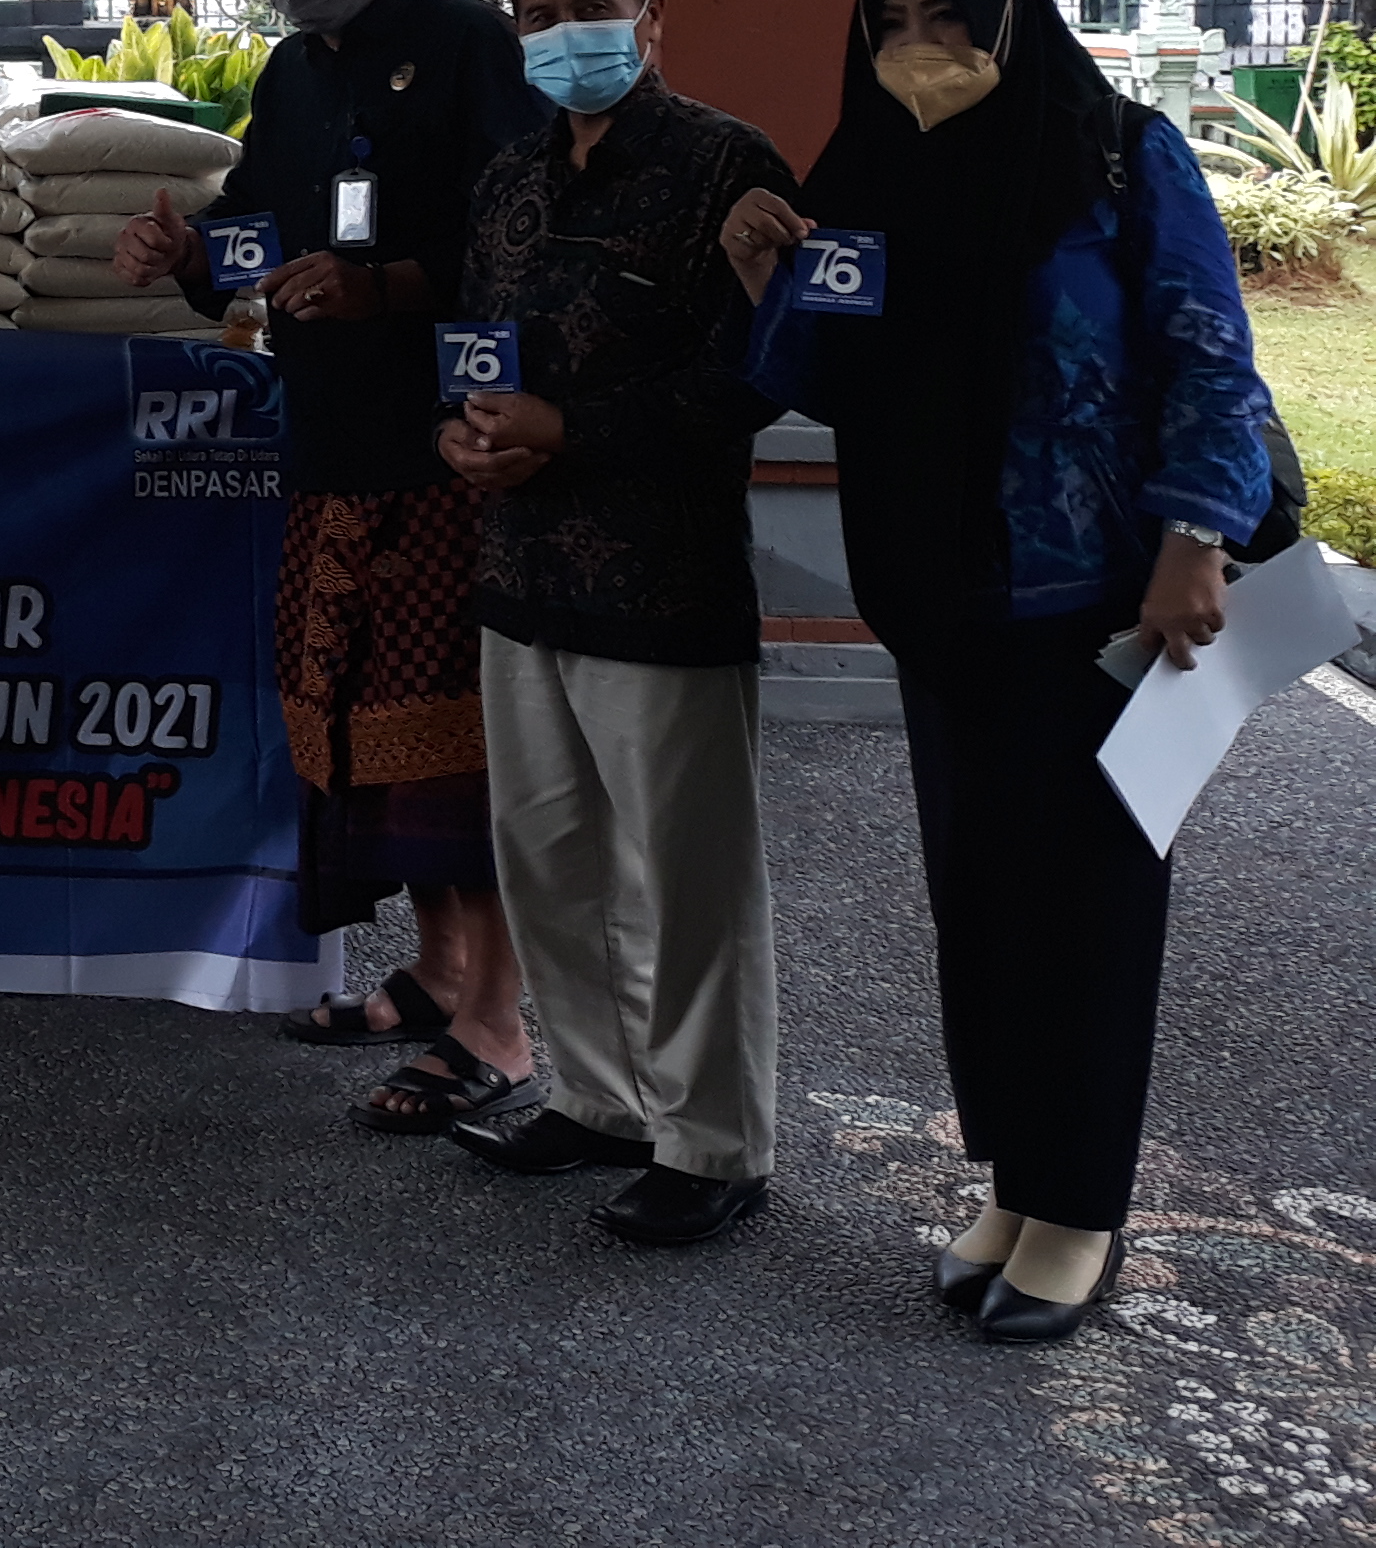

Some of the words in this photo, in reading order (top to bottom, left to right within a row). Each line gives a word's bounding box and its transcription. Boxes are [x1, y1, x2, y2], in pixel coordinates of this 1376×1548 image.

[208, 226, 265, 269] 76
[801, 239, 863, 294] 76
[443, 333, 501, 382] 76
[134, 389, 239, 439] RRI
[134, 469, 283, 499] DENPASAR
[75, 680, 214, 750] 2021
